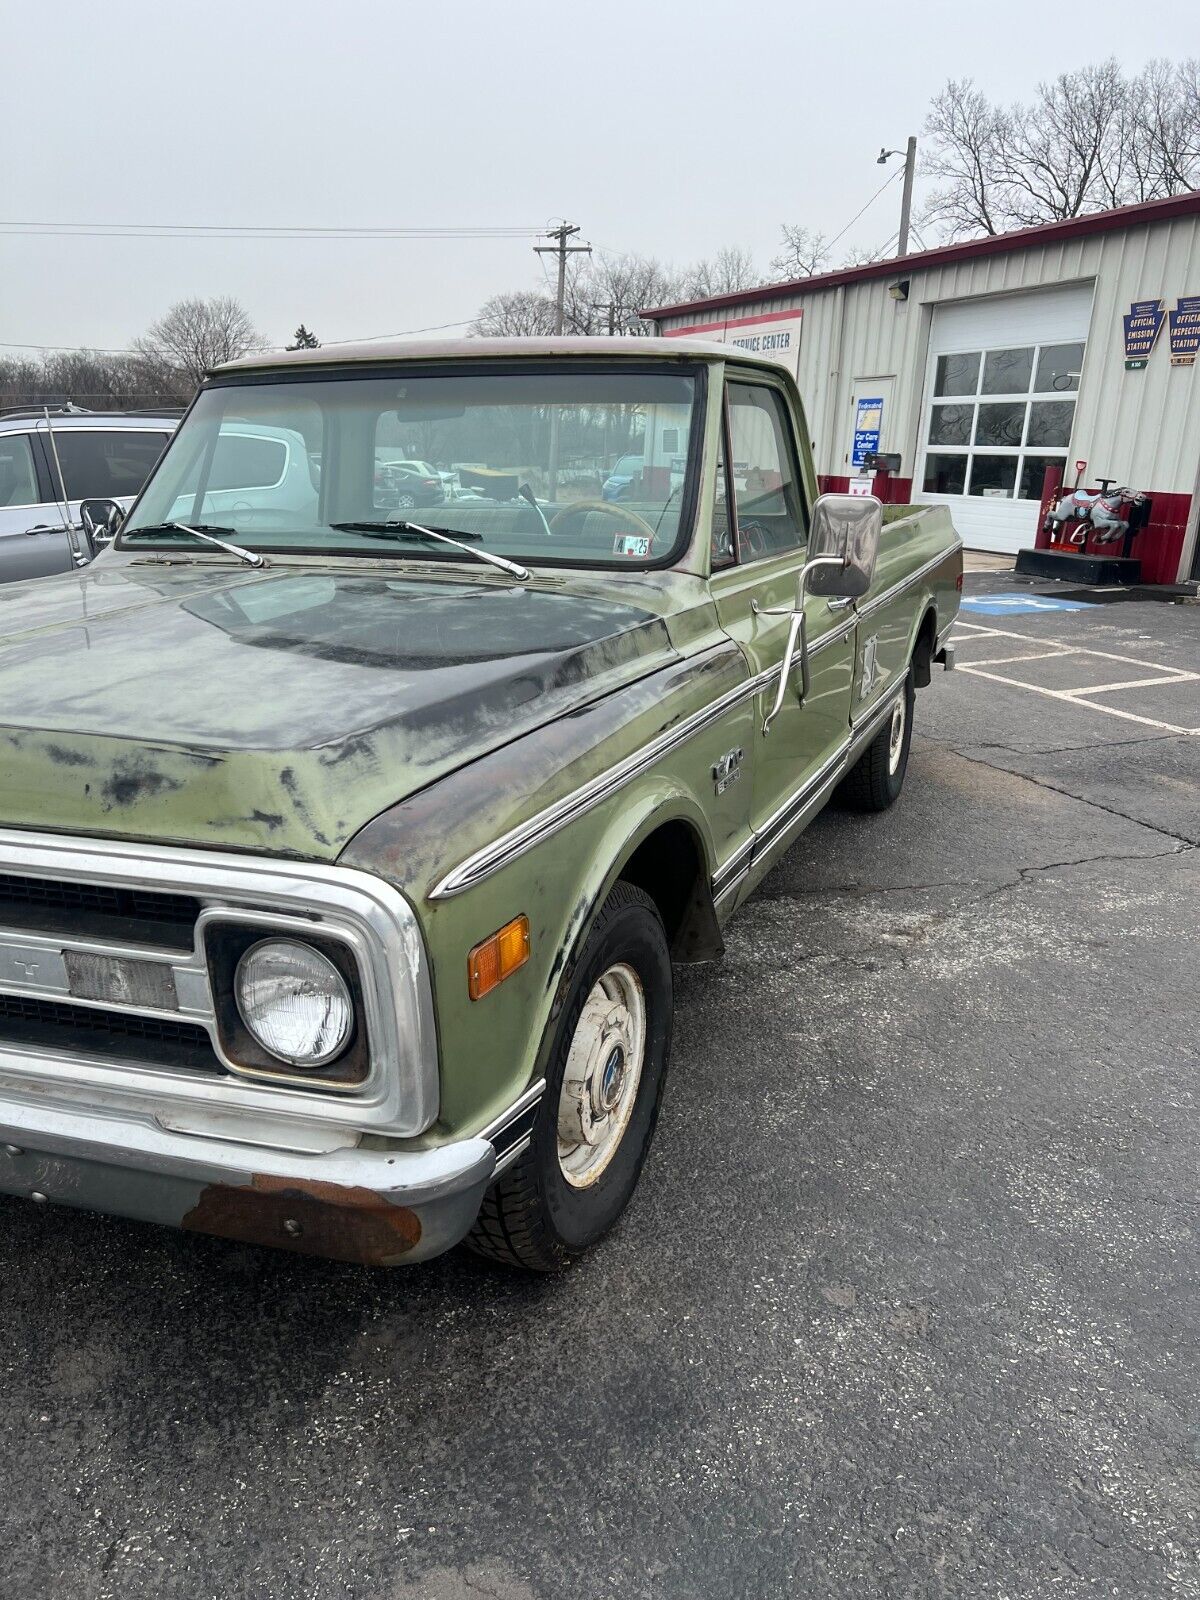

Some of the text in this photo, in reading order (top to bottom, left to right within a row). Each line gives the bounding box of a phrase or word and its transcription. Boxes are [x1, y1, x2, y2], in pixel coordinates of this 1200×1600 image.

[1130, 317, 1155, 327] OFFICIAL
[1127, 329, 1155, 340] EMISSION
[762, 332, 790, 350] CENTER
[1127, 341, 1151, 351] STATION
[1172, 338, 1199, 348] STATION
[855, 433, 878, 441] Car Care
[856, 441, 874, 449] Center
[638, 538, 648, 554] 25
